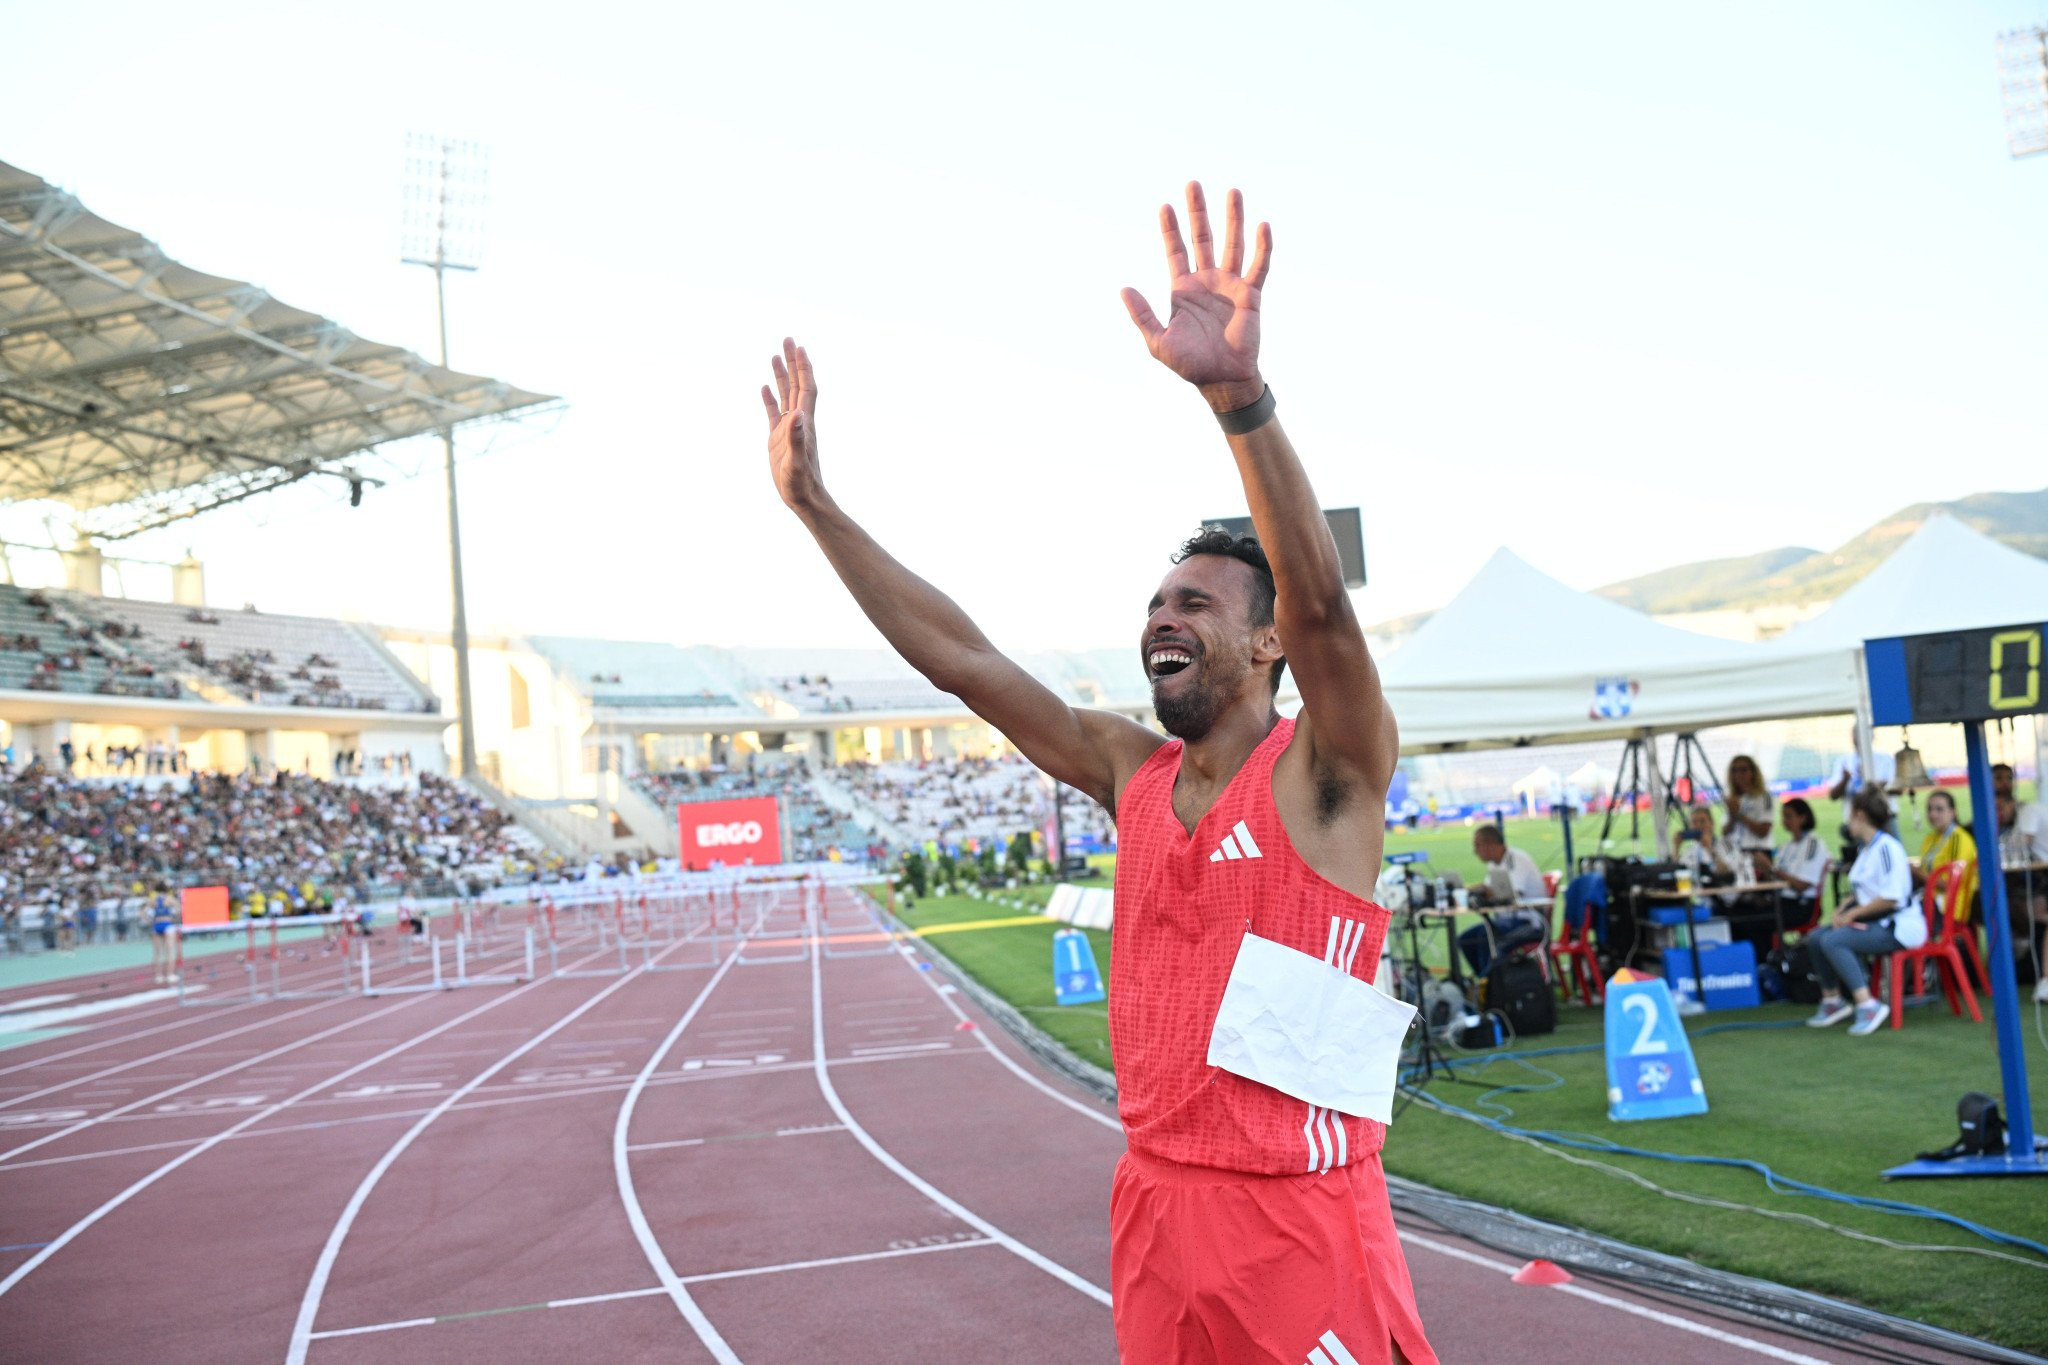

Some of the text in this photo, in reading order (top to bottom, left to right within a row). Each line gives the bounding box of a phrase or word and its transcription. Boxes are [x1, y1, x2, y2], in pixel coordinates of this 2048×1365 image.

[1989, 630, 2040, 710] 0
[696, 821, 762, 847] ERGO
[1066, 940, 1081, 971] 1
[1621, 993, 1668, 1055] 2
